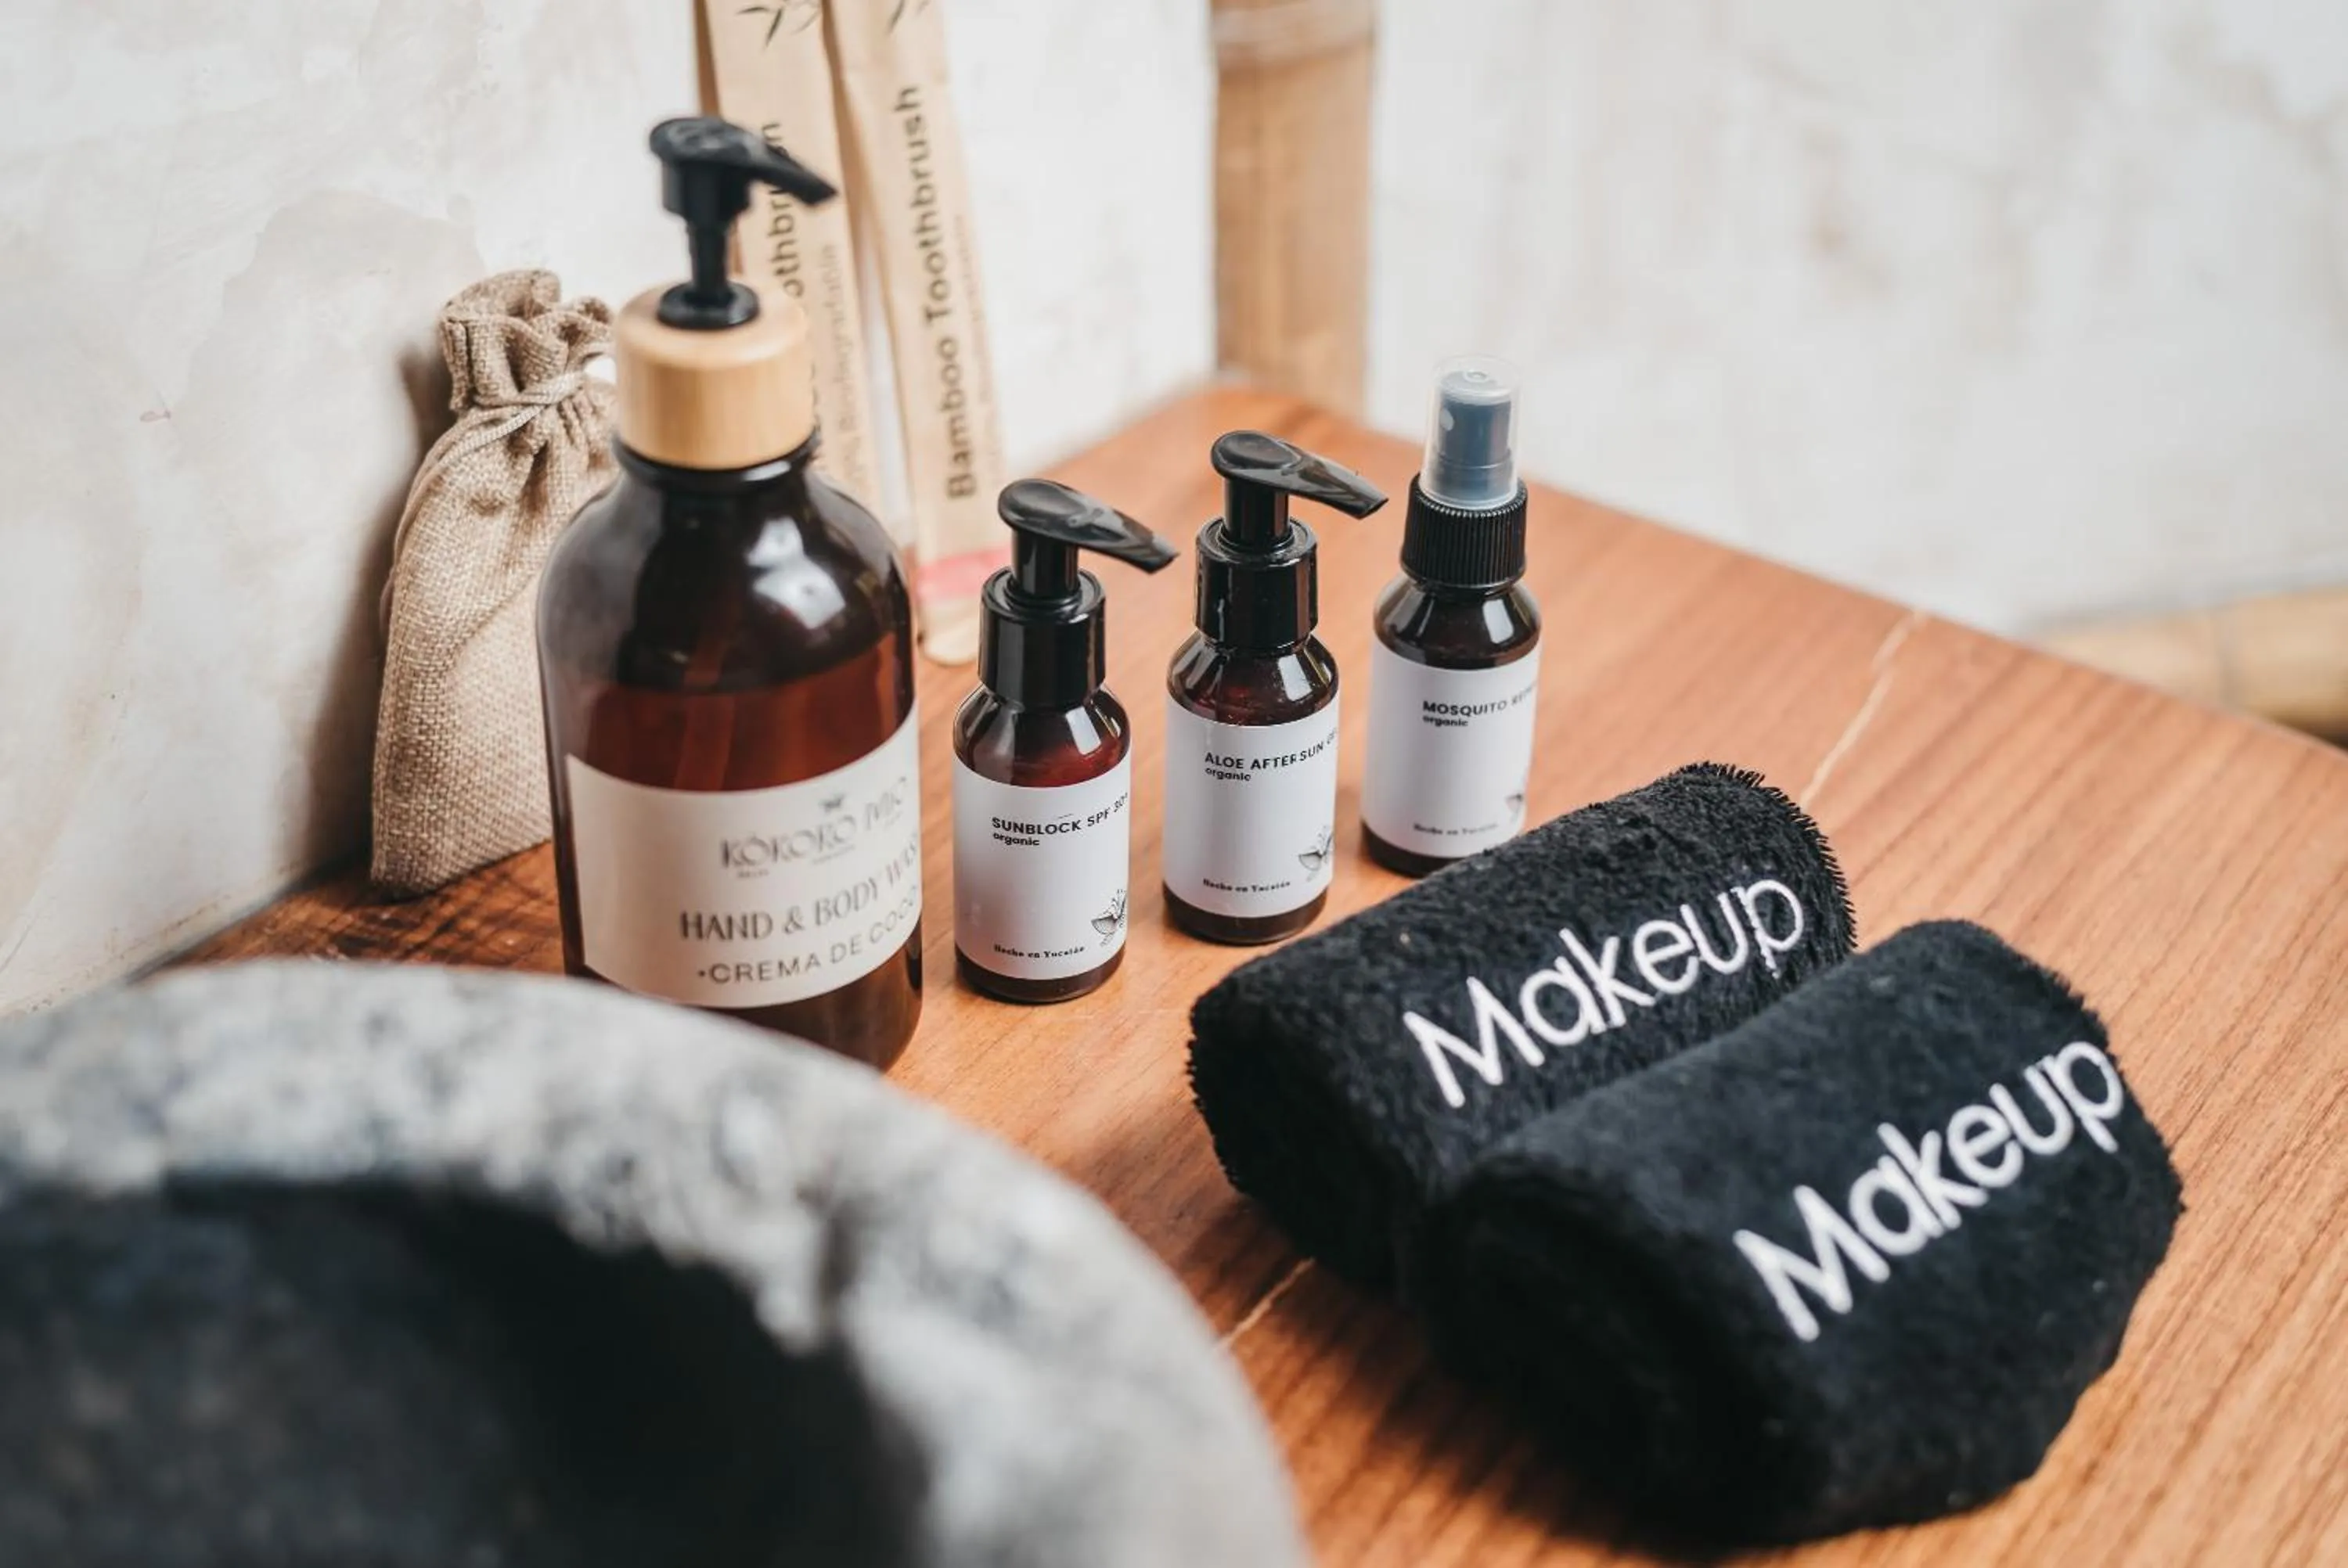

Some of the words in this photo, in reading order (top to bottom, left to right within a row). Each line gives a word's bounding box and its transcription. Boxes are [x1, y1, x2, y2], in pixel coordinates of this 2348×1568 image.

[893, 86, 951, 325] Toothbrush
[938, 336, 977, 498] Bamboo
[1422, 700, 1507, 717] MOSQUITO
[1422, 714, 1468, 727] organic
[1205, 752, 1244, 769] ALOE
[1205, 767, 1251, 781] organic
[991, 816, 1082, 835] SUNBLOCK
[1087, 807, 1110, 827] SPF
[992, 832, 1040, 847] organic
[679, 911, 773, 941] HAND
[783, 905, 805, 936] &
[814, 870, 881, 926] BODY
[831, 934, 862, 964] DE
[994, 944, 1025, 957] Hecho
[1403, 878, 1804, 1109] Makeup
[1732, 1041, 2123, 1342] Makeup
